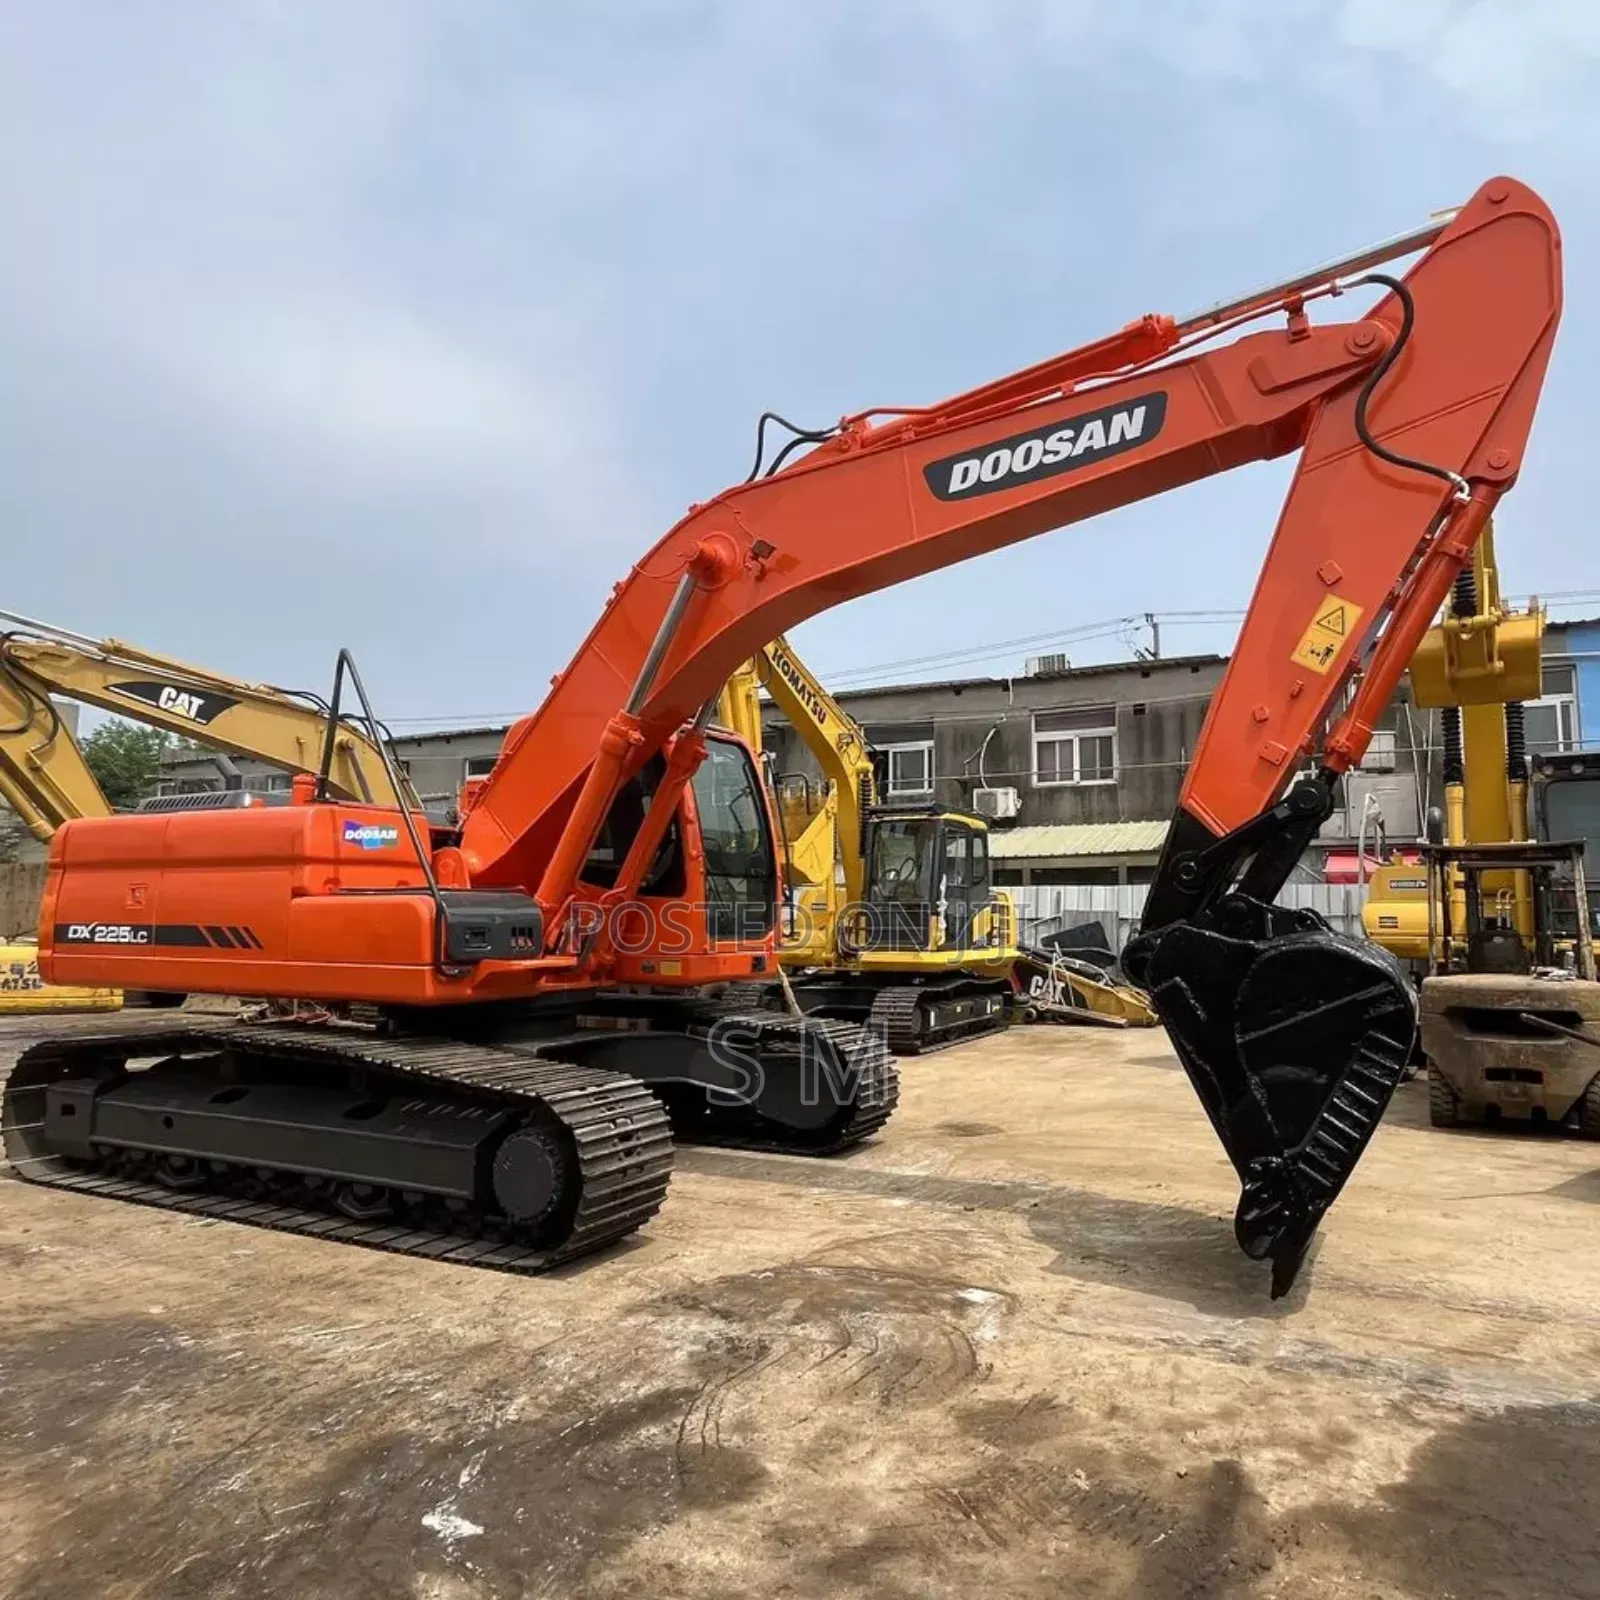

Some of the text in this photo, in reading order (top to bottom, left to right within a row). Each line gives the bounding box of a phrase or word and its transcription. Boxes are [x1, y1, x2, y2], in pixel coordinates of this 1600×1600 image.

[947, 405, 1147, 494] DOOSAN
[157, 685, 205, 719] CAT
[771, 646, 826, 725] KOMATSU
[344, 828, 398, 840] DOOSAN
[1029, 974, 1066, 1004] CAT
